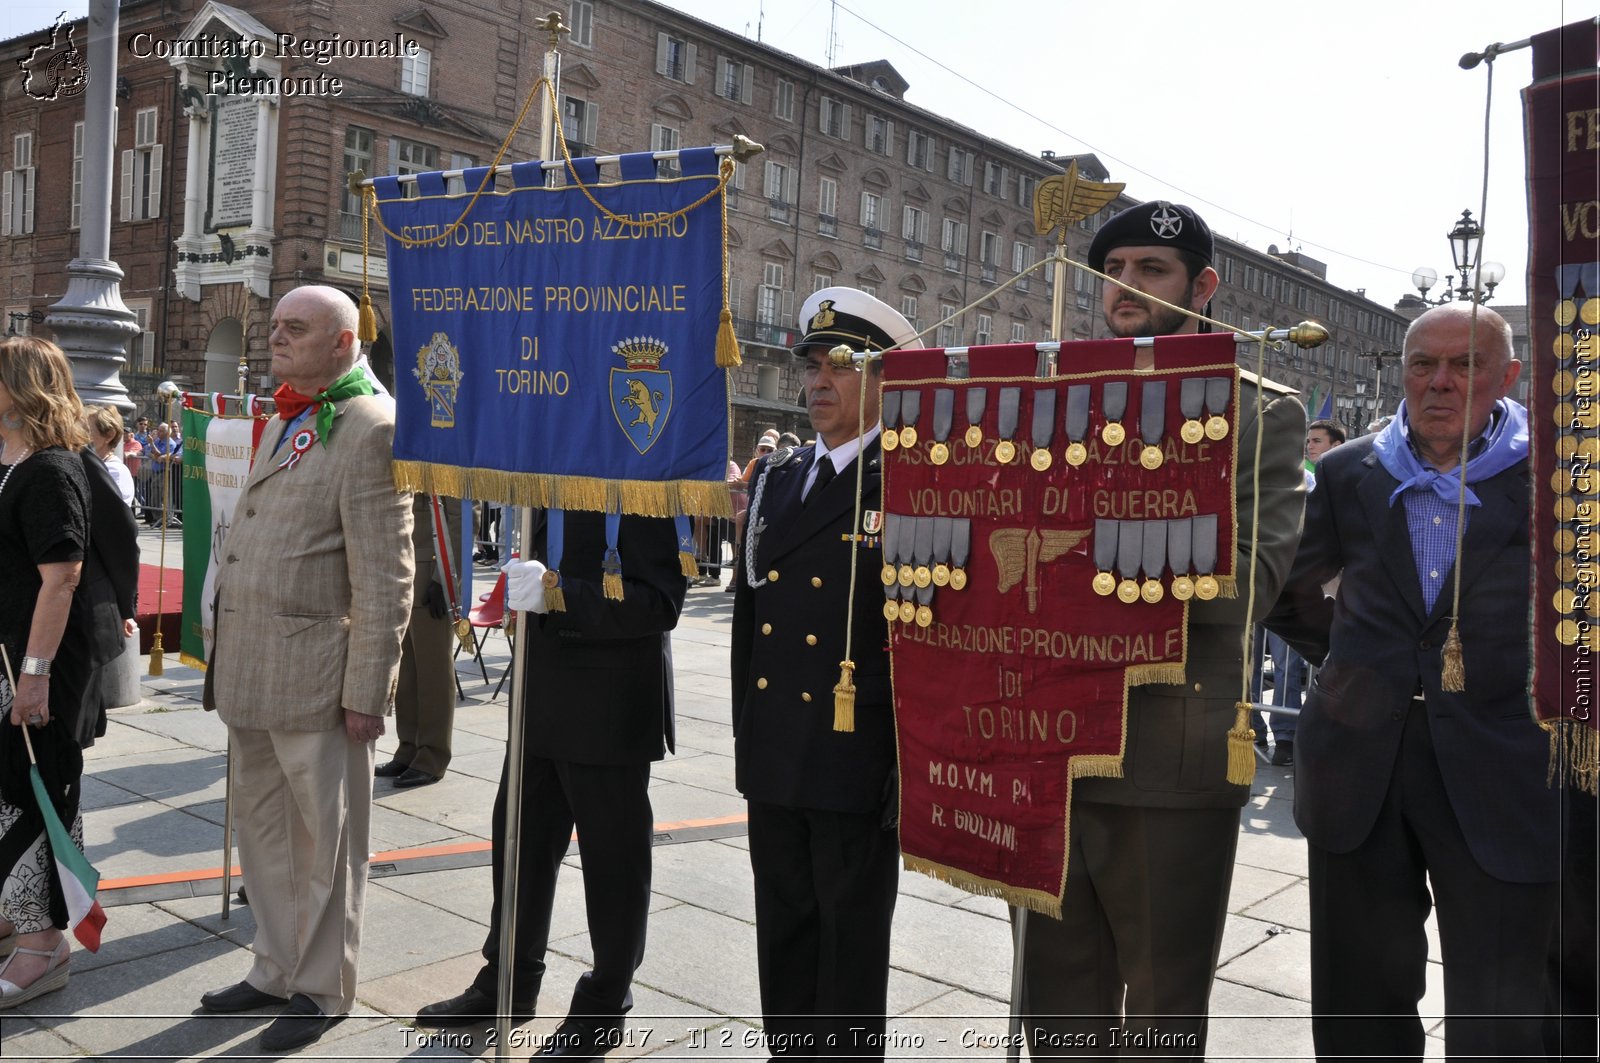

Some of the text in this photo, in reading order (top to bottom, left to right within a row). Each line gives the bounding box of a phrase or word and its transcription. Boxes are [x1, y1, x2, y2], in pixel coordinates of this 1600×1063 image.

[400, 212, 689, 249] ISTITUTO DEL NASTRO AZZURRO
[412, 285, 687, 312] FEDERAZIONE PROVINCIALE
[521, 336, 539, 361] DI
[495, 369, 569, 396] TORINO
[908, 487, 1199, 518] VOLONTARI DI GUERRA
[897, 619, 1181, 663] EDERAZIONE PROVINCIALE
[1005, 671, 1023, 697] DI
[962, 705, 1077, 744] TORINO
[929, 760, 997, 798] M.O.V.M.
[931, 802, 1016, 852] R. GIULIANI
